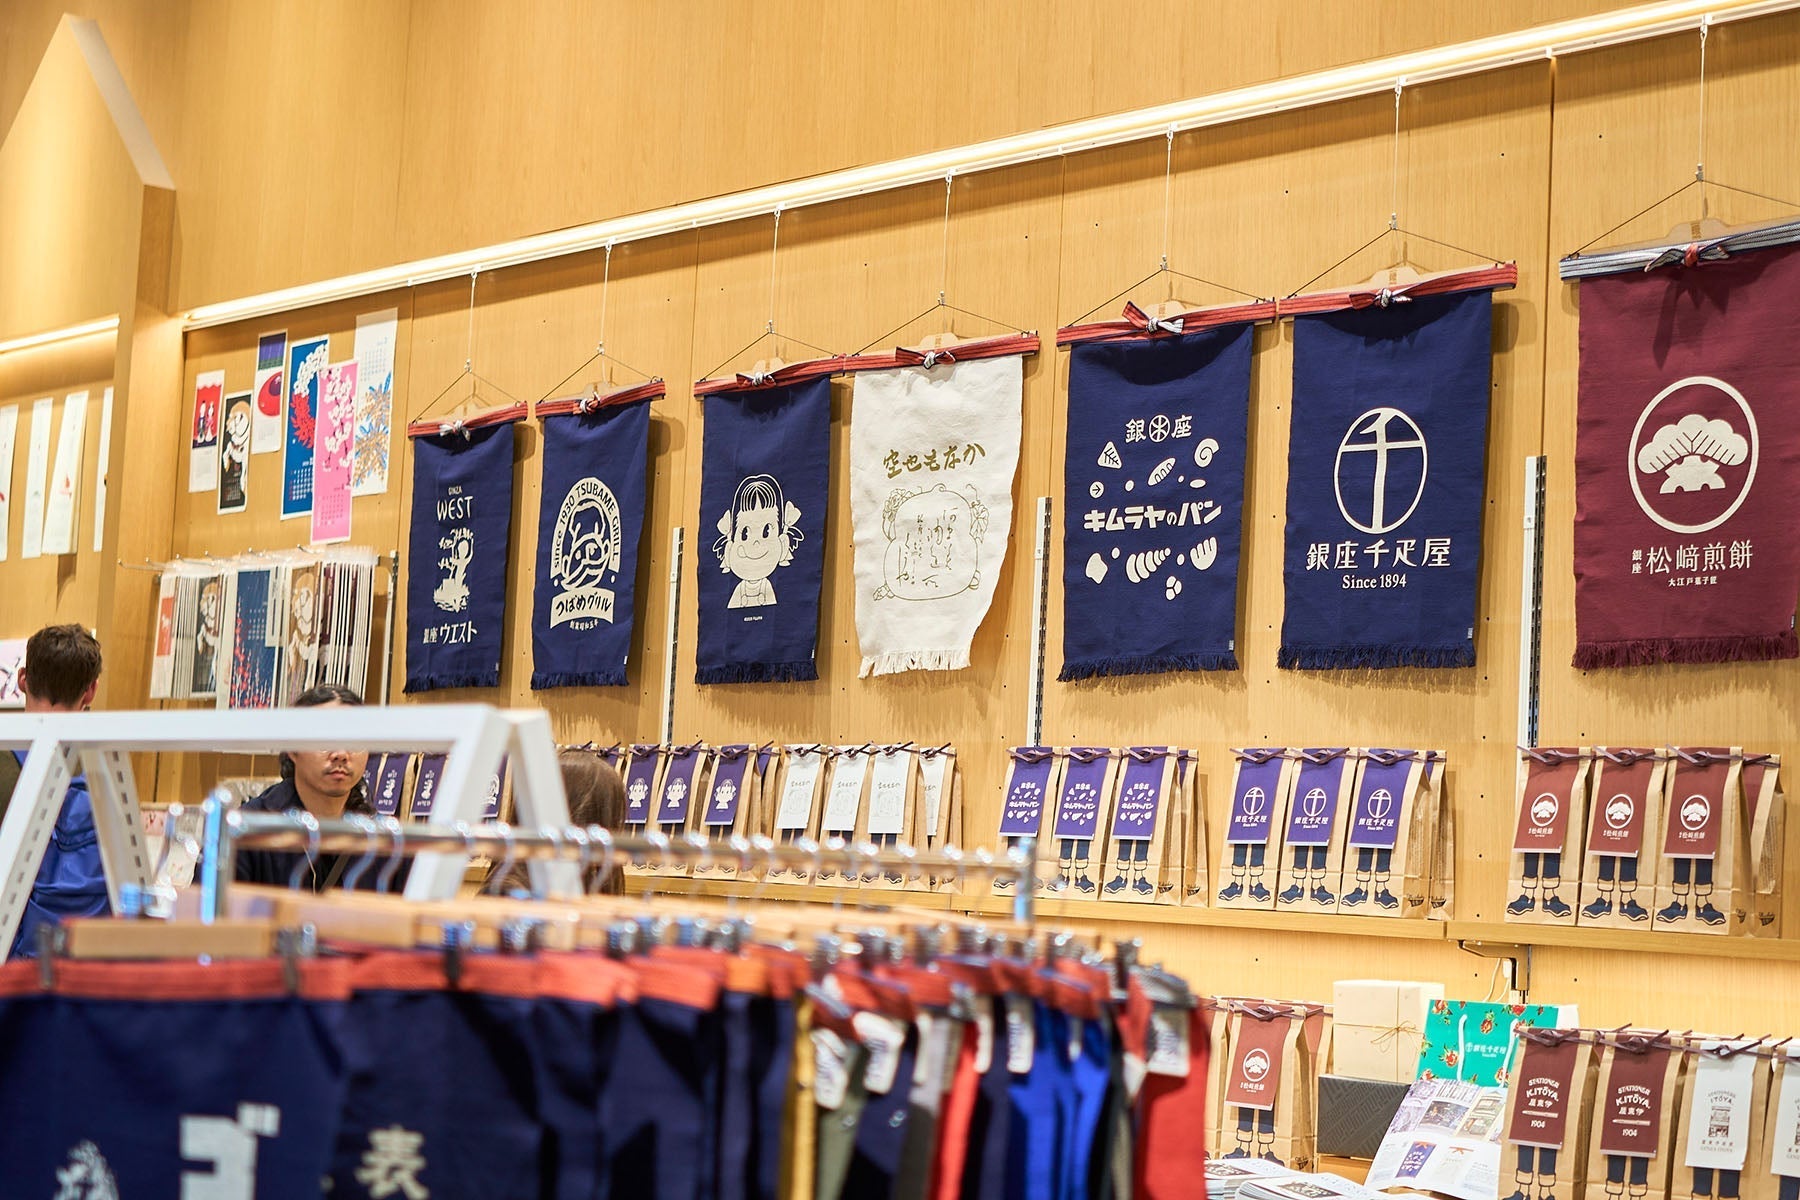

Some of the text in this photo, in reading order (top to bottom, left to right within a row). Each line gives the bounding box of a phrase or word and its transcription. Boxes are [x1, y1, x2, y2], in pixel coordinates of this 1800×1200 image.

[883, 443, 986, 479] 空也もなか
[437, 495, 474, 521] WEST
[1083, 499, 1223, 533] キムラヤのパン
[554, 482, 620, 568] since 1930 TSUBAME GRILL
[1305, 537, 1452, 571] 銀座千疋屋
[1631, 548, 1643, 575] 銀座
[1341, 573, 1407, 589] Since 1894
[556, 592, 612, 616] つばめグリル
[1530, 1120, 1546, 1129] 1904
[1622, 1128, 1638, 1137] 1904
